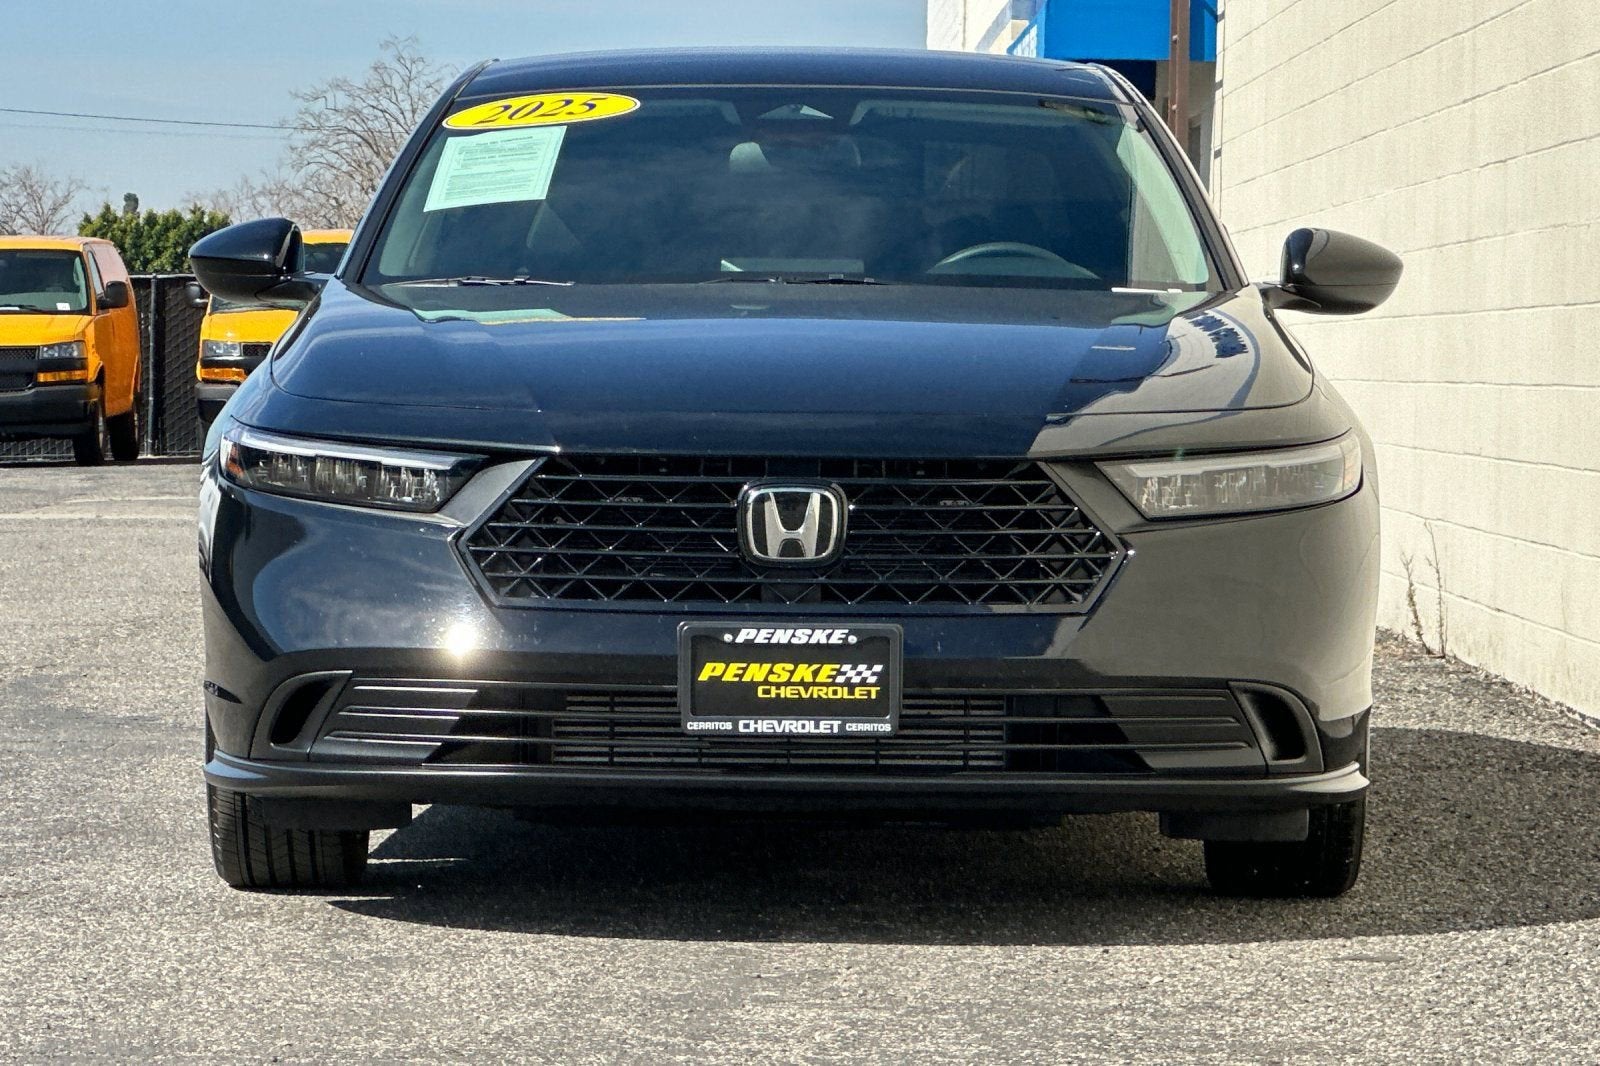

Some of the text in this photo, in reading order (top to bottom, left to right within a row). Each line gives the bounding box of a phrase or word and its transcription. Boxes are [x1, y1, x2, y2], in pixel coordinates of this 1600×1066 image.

[474, 97, 608, 124] 2025
[735, 628, 849, 644] PENSKE
[698, 662, 842, 683] PENSKE
[757, 685, 881, 700] CHEVROLET
[686, 719, 892, 734] CERRITOS CHEVROLET CERRITOS
